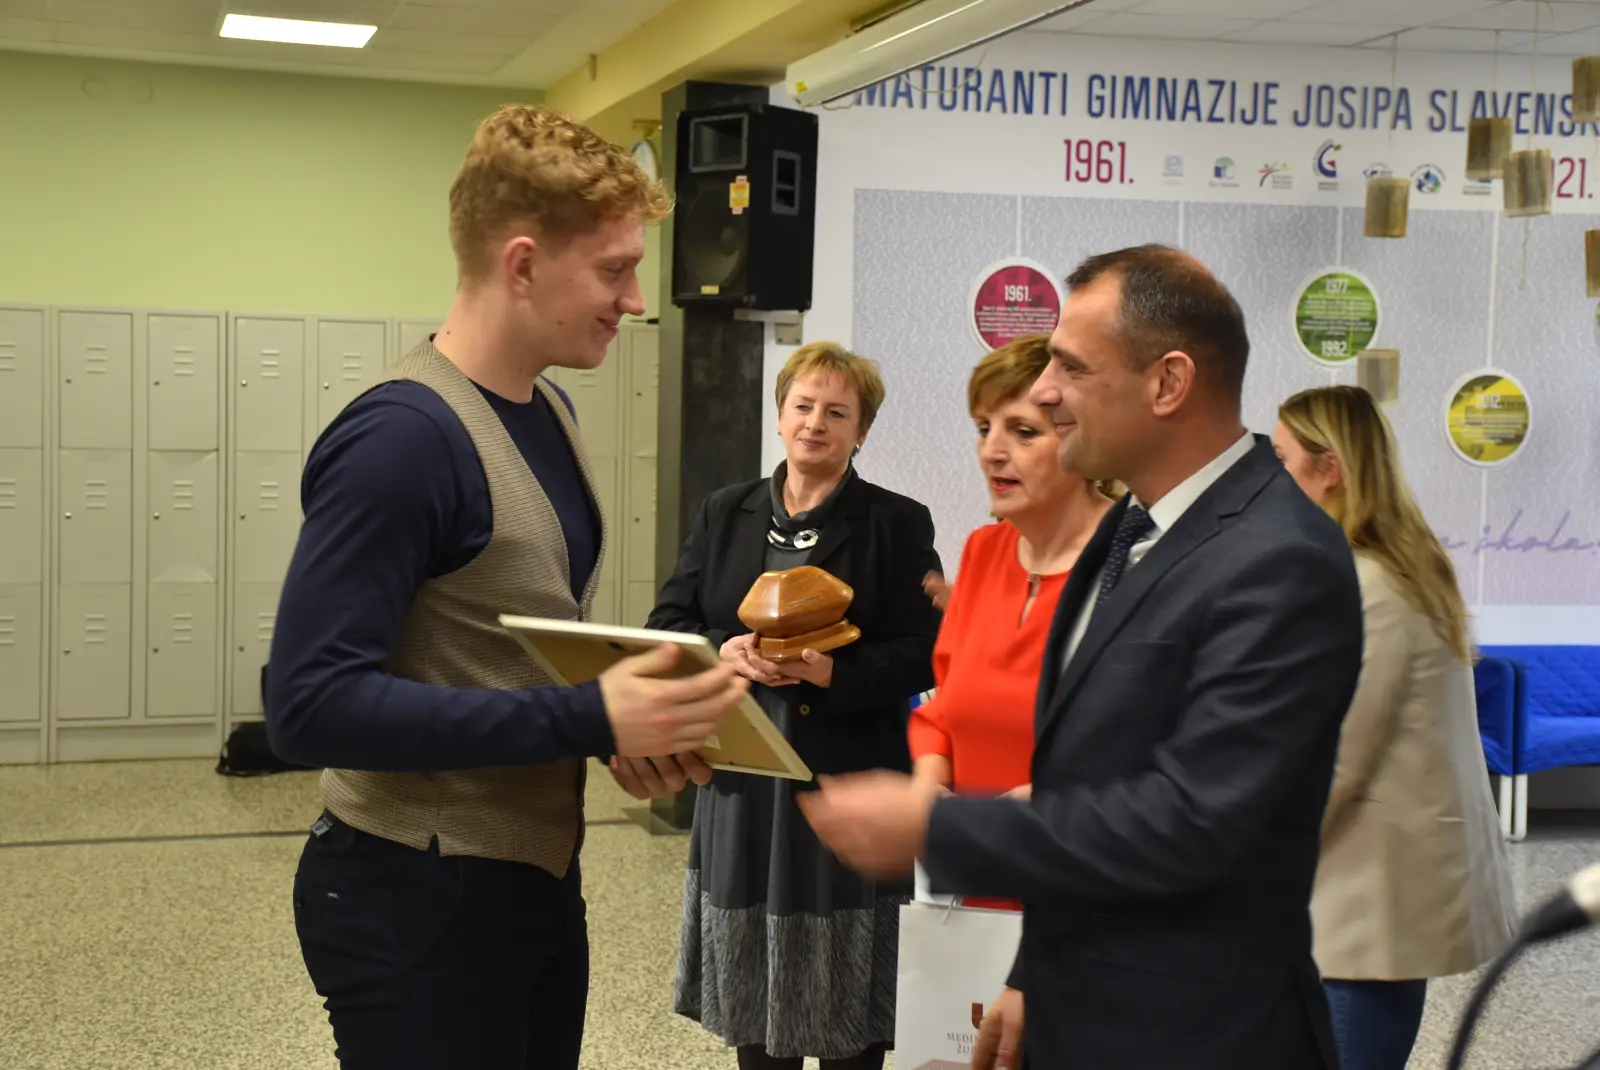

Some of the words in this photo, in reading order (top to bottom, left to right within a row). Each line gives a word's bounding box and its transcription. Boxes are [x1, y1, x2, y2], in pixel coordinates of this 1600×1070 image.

[1087, 73, 1280, 126] GIMNAZIJE
[1293, 84, 1413, 131] JOSIPA
[1063, 138, 1134, 184] 1961.
[1004, 285, 1032, 302] 1961.
